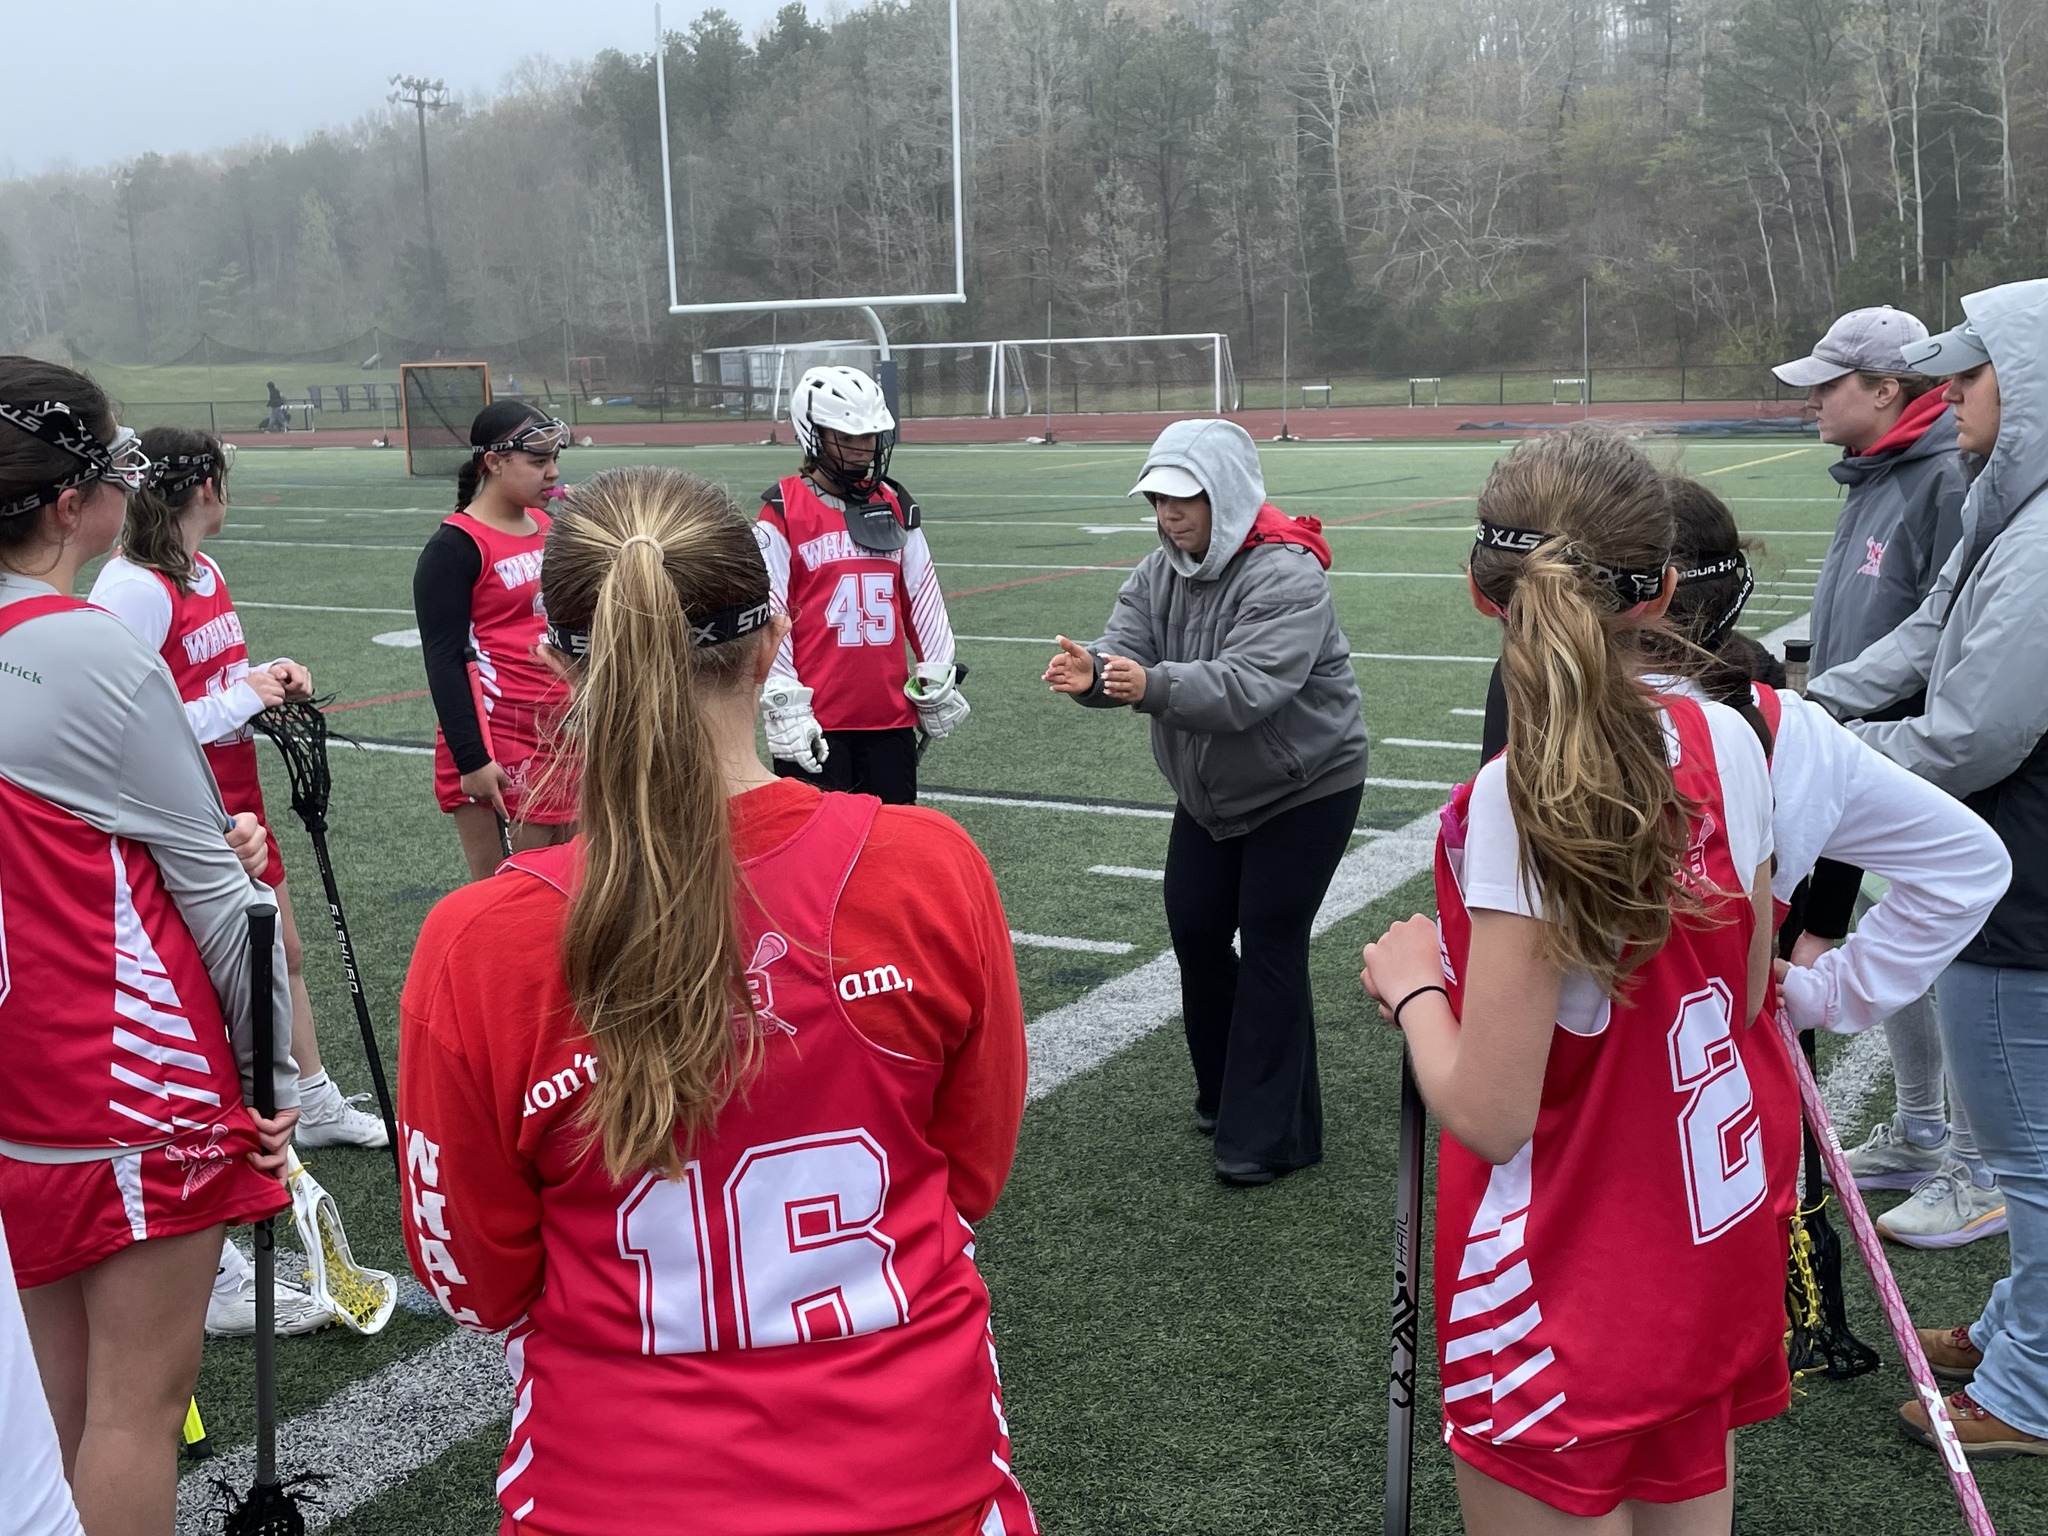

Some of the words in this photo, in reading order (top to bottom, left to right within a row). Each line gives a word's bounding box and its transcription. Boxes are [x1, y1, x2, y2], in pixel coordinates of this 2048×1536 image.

[27, 400, 70, 417] STX
[173, 472, 201, 492] STX
[1490, 528, 1544, 549] STX
[824, 572, 896, 647] 45
[1667, 977, 1768, 1245] 2
[616, 1127, 909, 1356] 16
[1396, 1212, 1409, 1266] HAIL
[1918, 1382, 1971, 1473] STX
